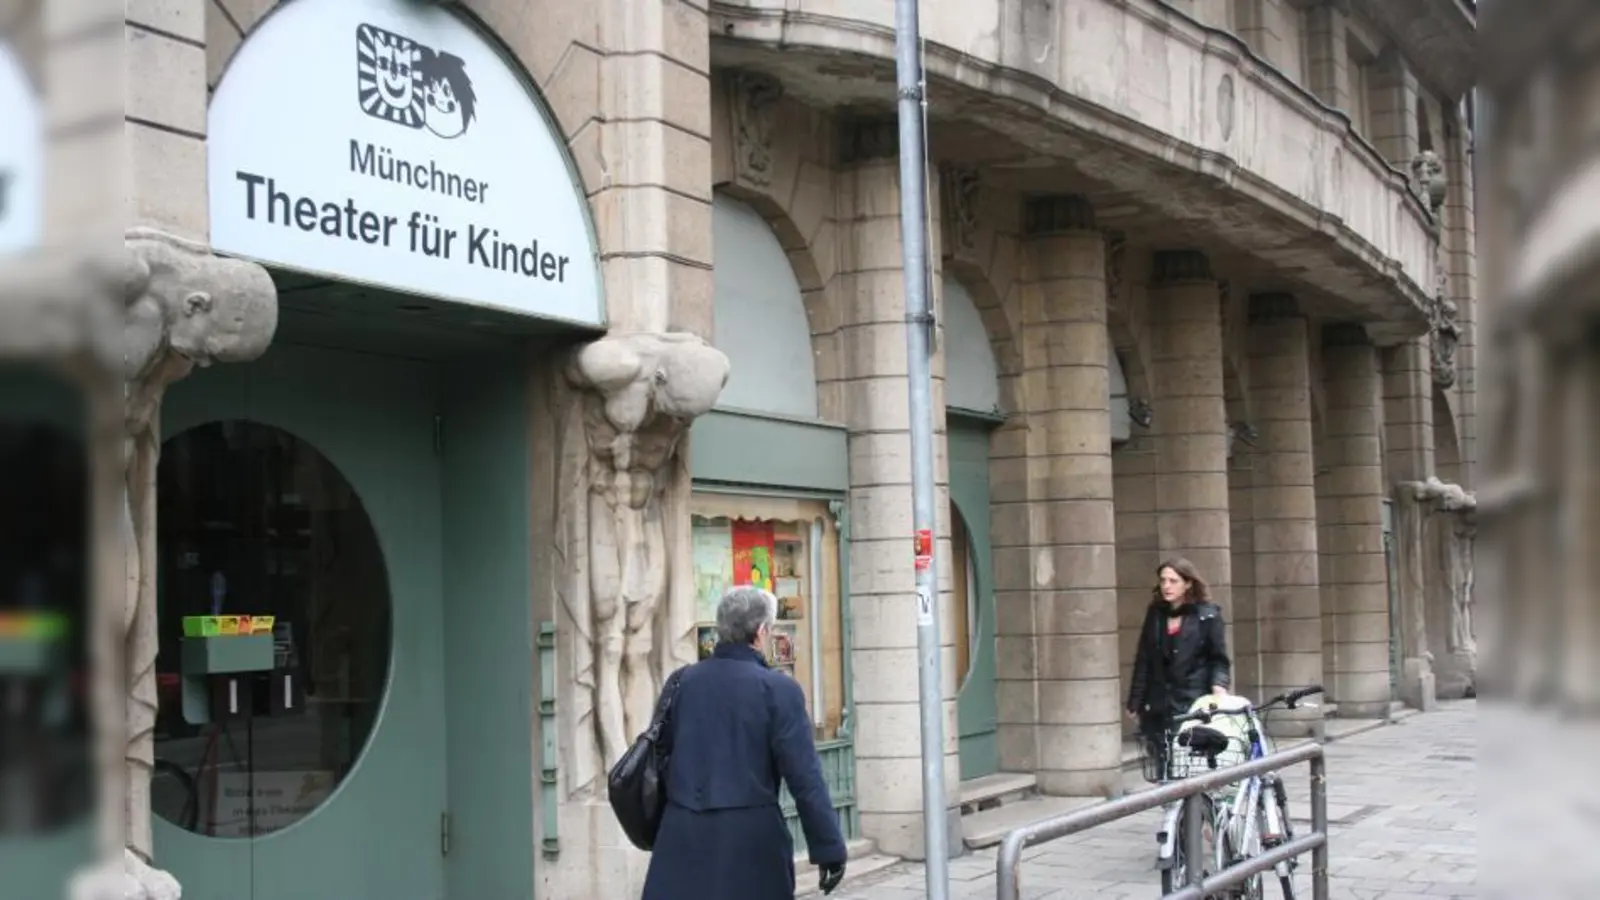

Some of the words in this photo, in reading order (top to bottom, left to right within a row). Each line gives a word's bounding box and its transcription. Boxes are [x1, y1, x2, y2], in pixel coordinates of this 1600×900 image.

[349, 138, 489, 204] Münchner
[236, 171, 398, 247] Theater
[407, 211, 457, 259] für
[468, 224, 570, 283] Kinder
